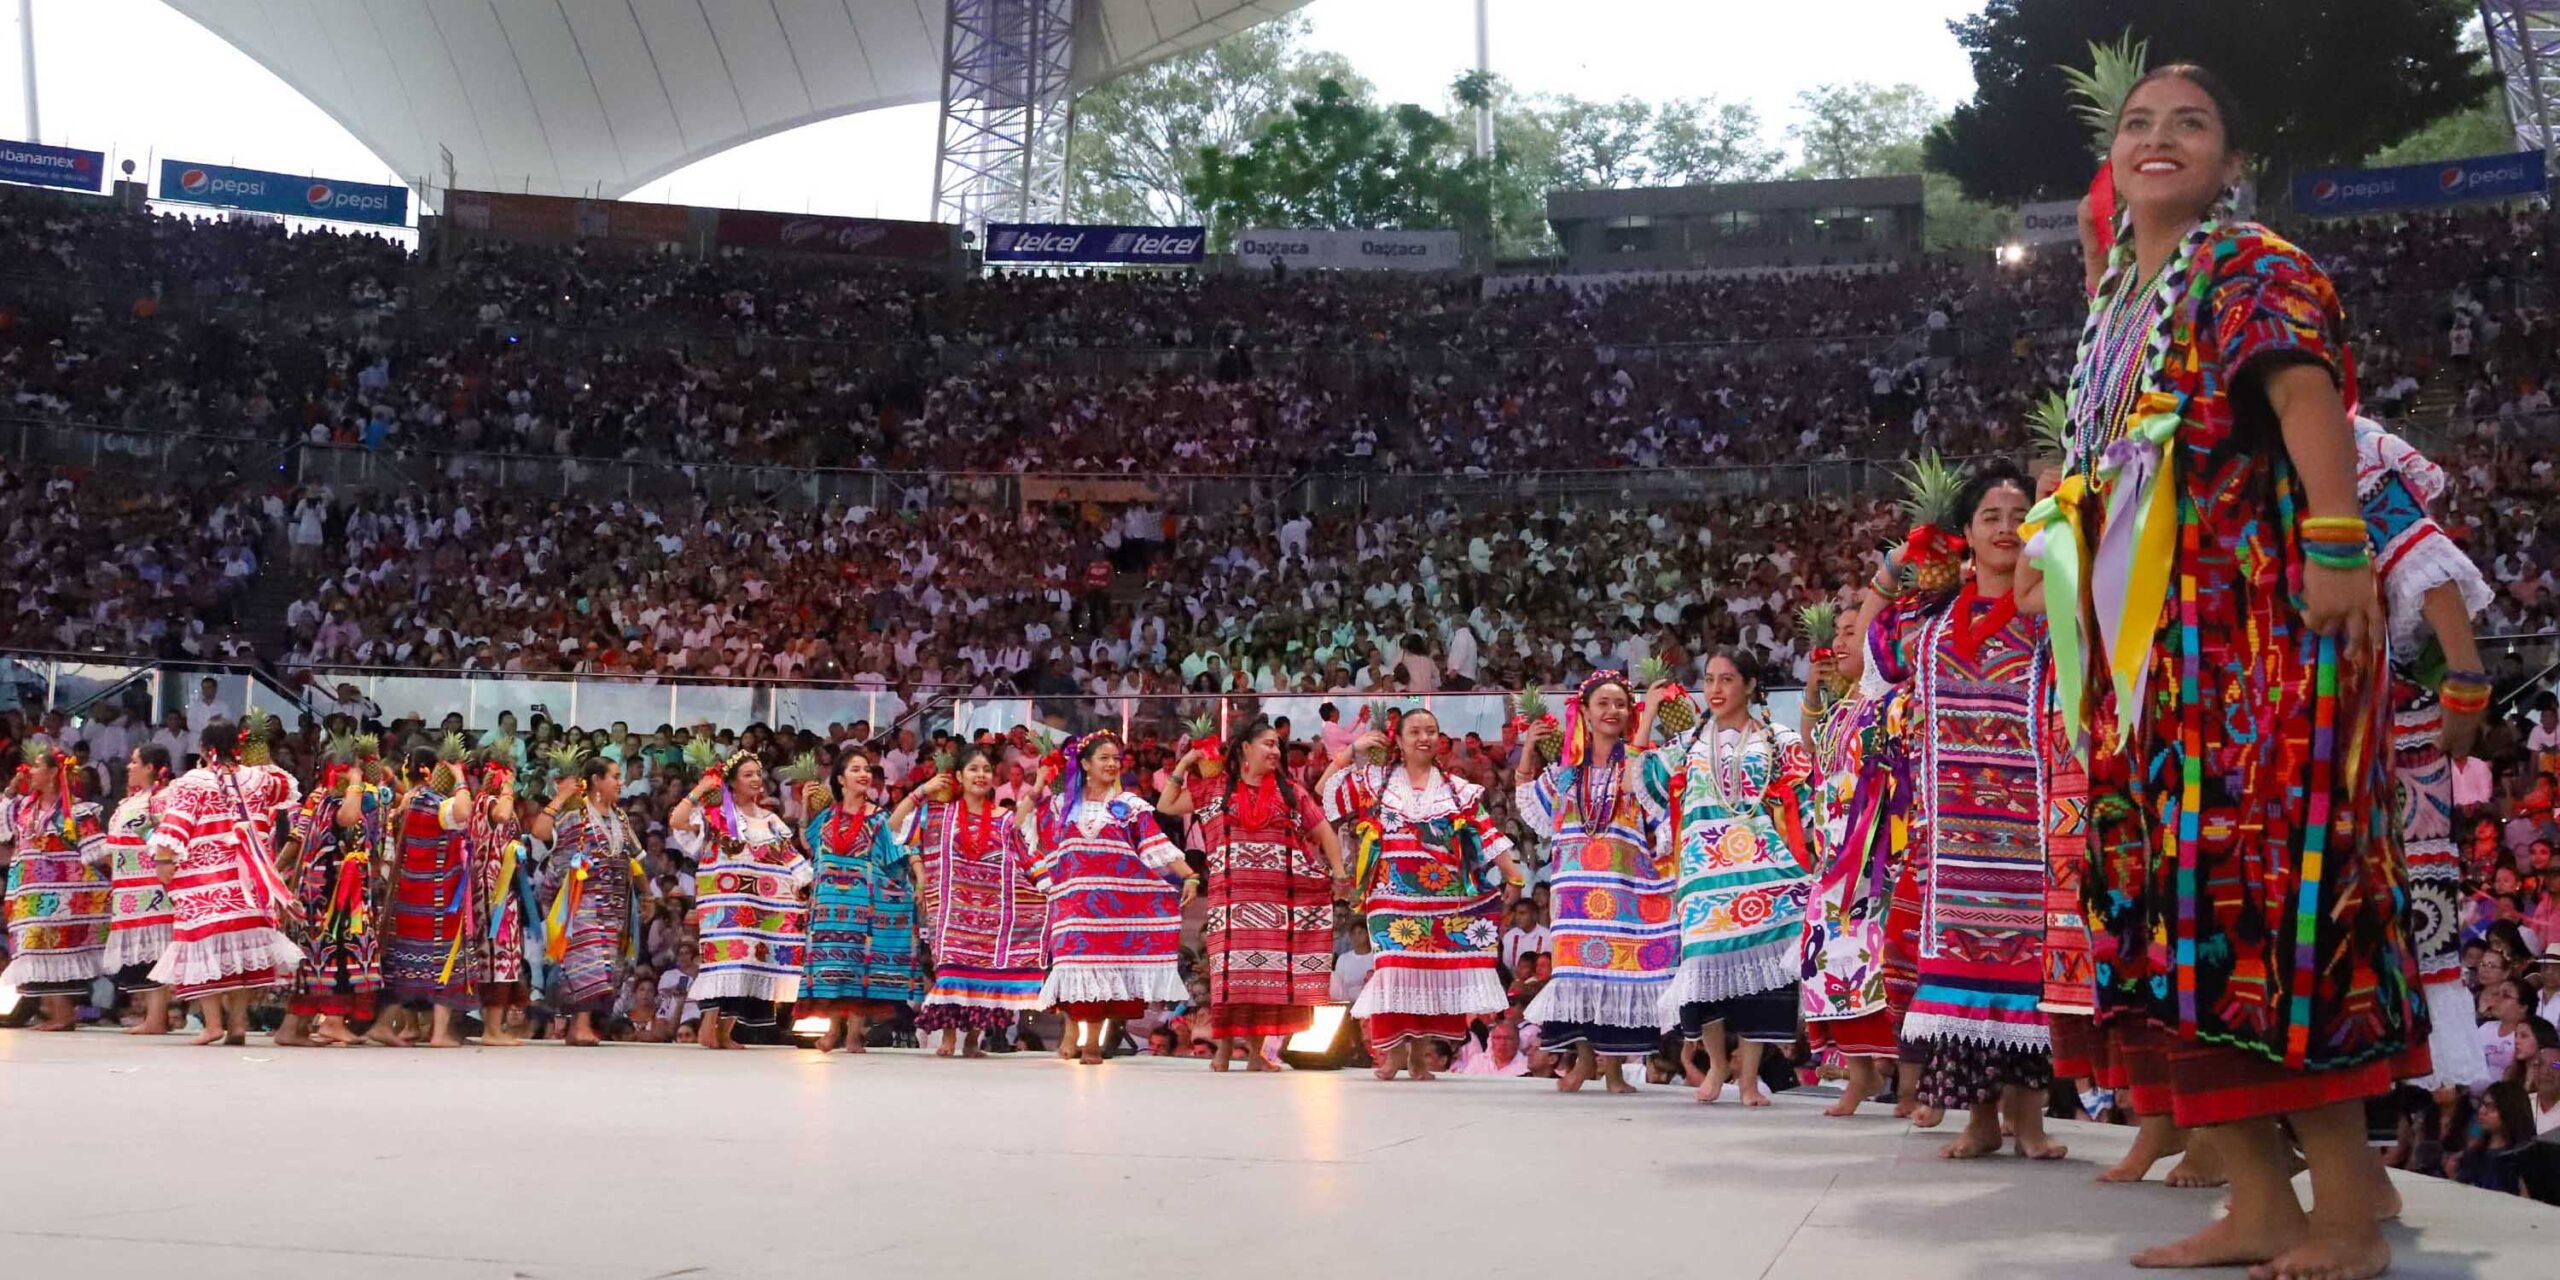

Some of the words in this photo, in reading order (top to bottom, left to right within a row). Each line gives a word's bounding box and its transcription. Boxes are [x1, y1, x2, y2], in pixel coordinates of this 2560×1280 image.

[2469, 164, 2524, 186] pepsi
[211, 177, 265, 196] pepsi
[2342, 179, 2395, 199] pepsi
[335, 192, 389, 210] pepsi
[1017, 232, 1084, 253] telcel
[1132, 234, 1202, 254] telcel
[1243, 240, 1310, 256] Oaxaca
[1362, 241, 1427, 256] Oaxaca
